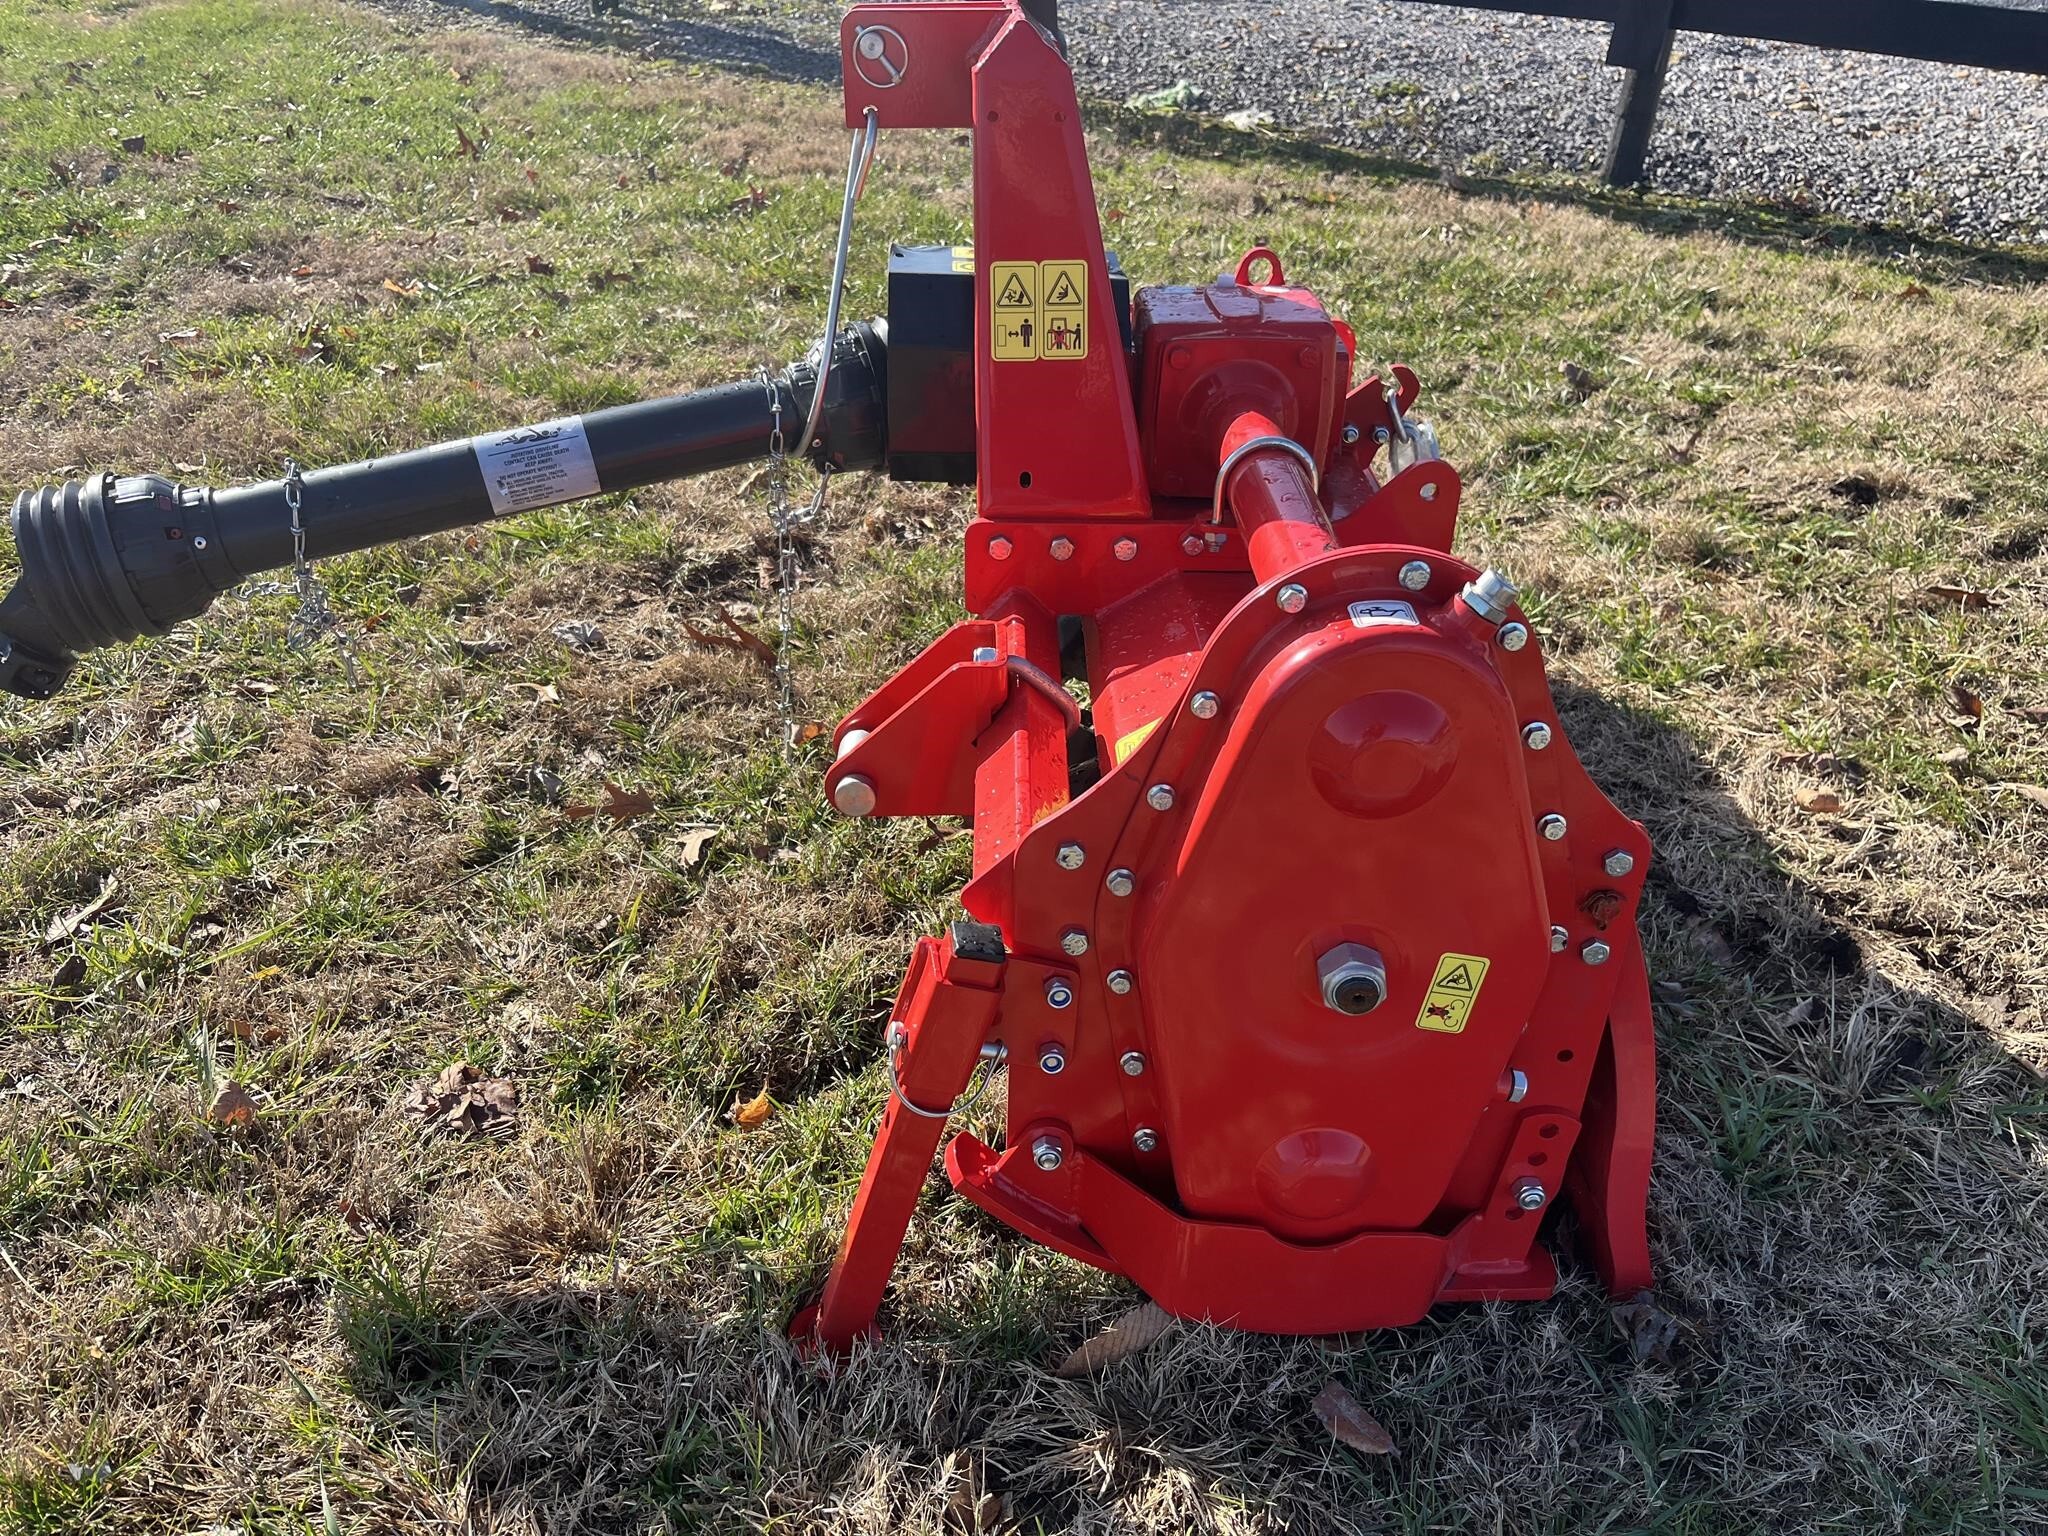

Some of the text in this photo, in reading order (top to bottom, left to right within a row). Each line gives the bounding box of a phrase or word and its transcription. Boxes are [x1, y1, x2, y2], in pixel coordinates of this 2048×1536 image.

[504, 447, 570, 466] CONTACT CAN CAUSE DEATH
[516, 468, 536, 477] OPERATE
